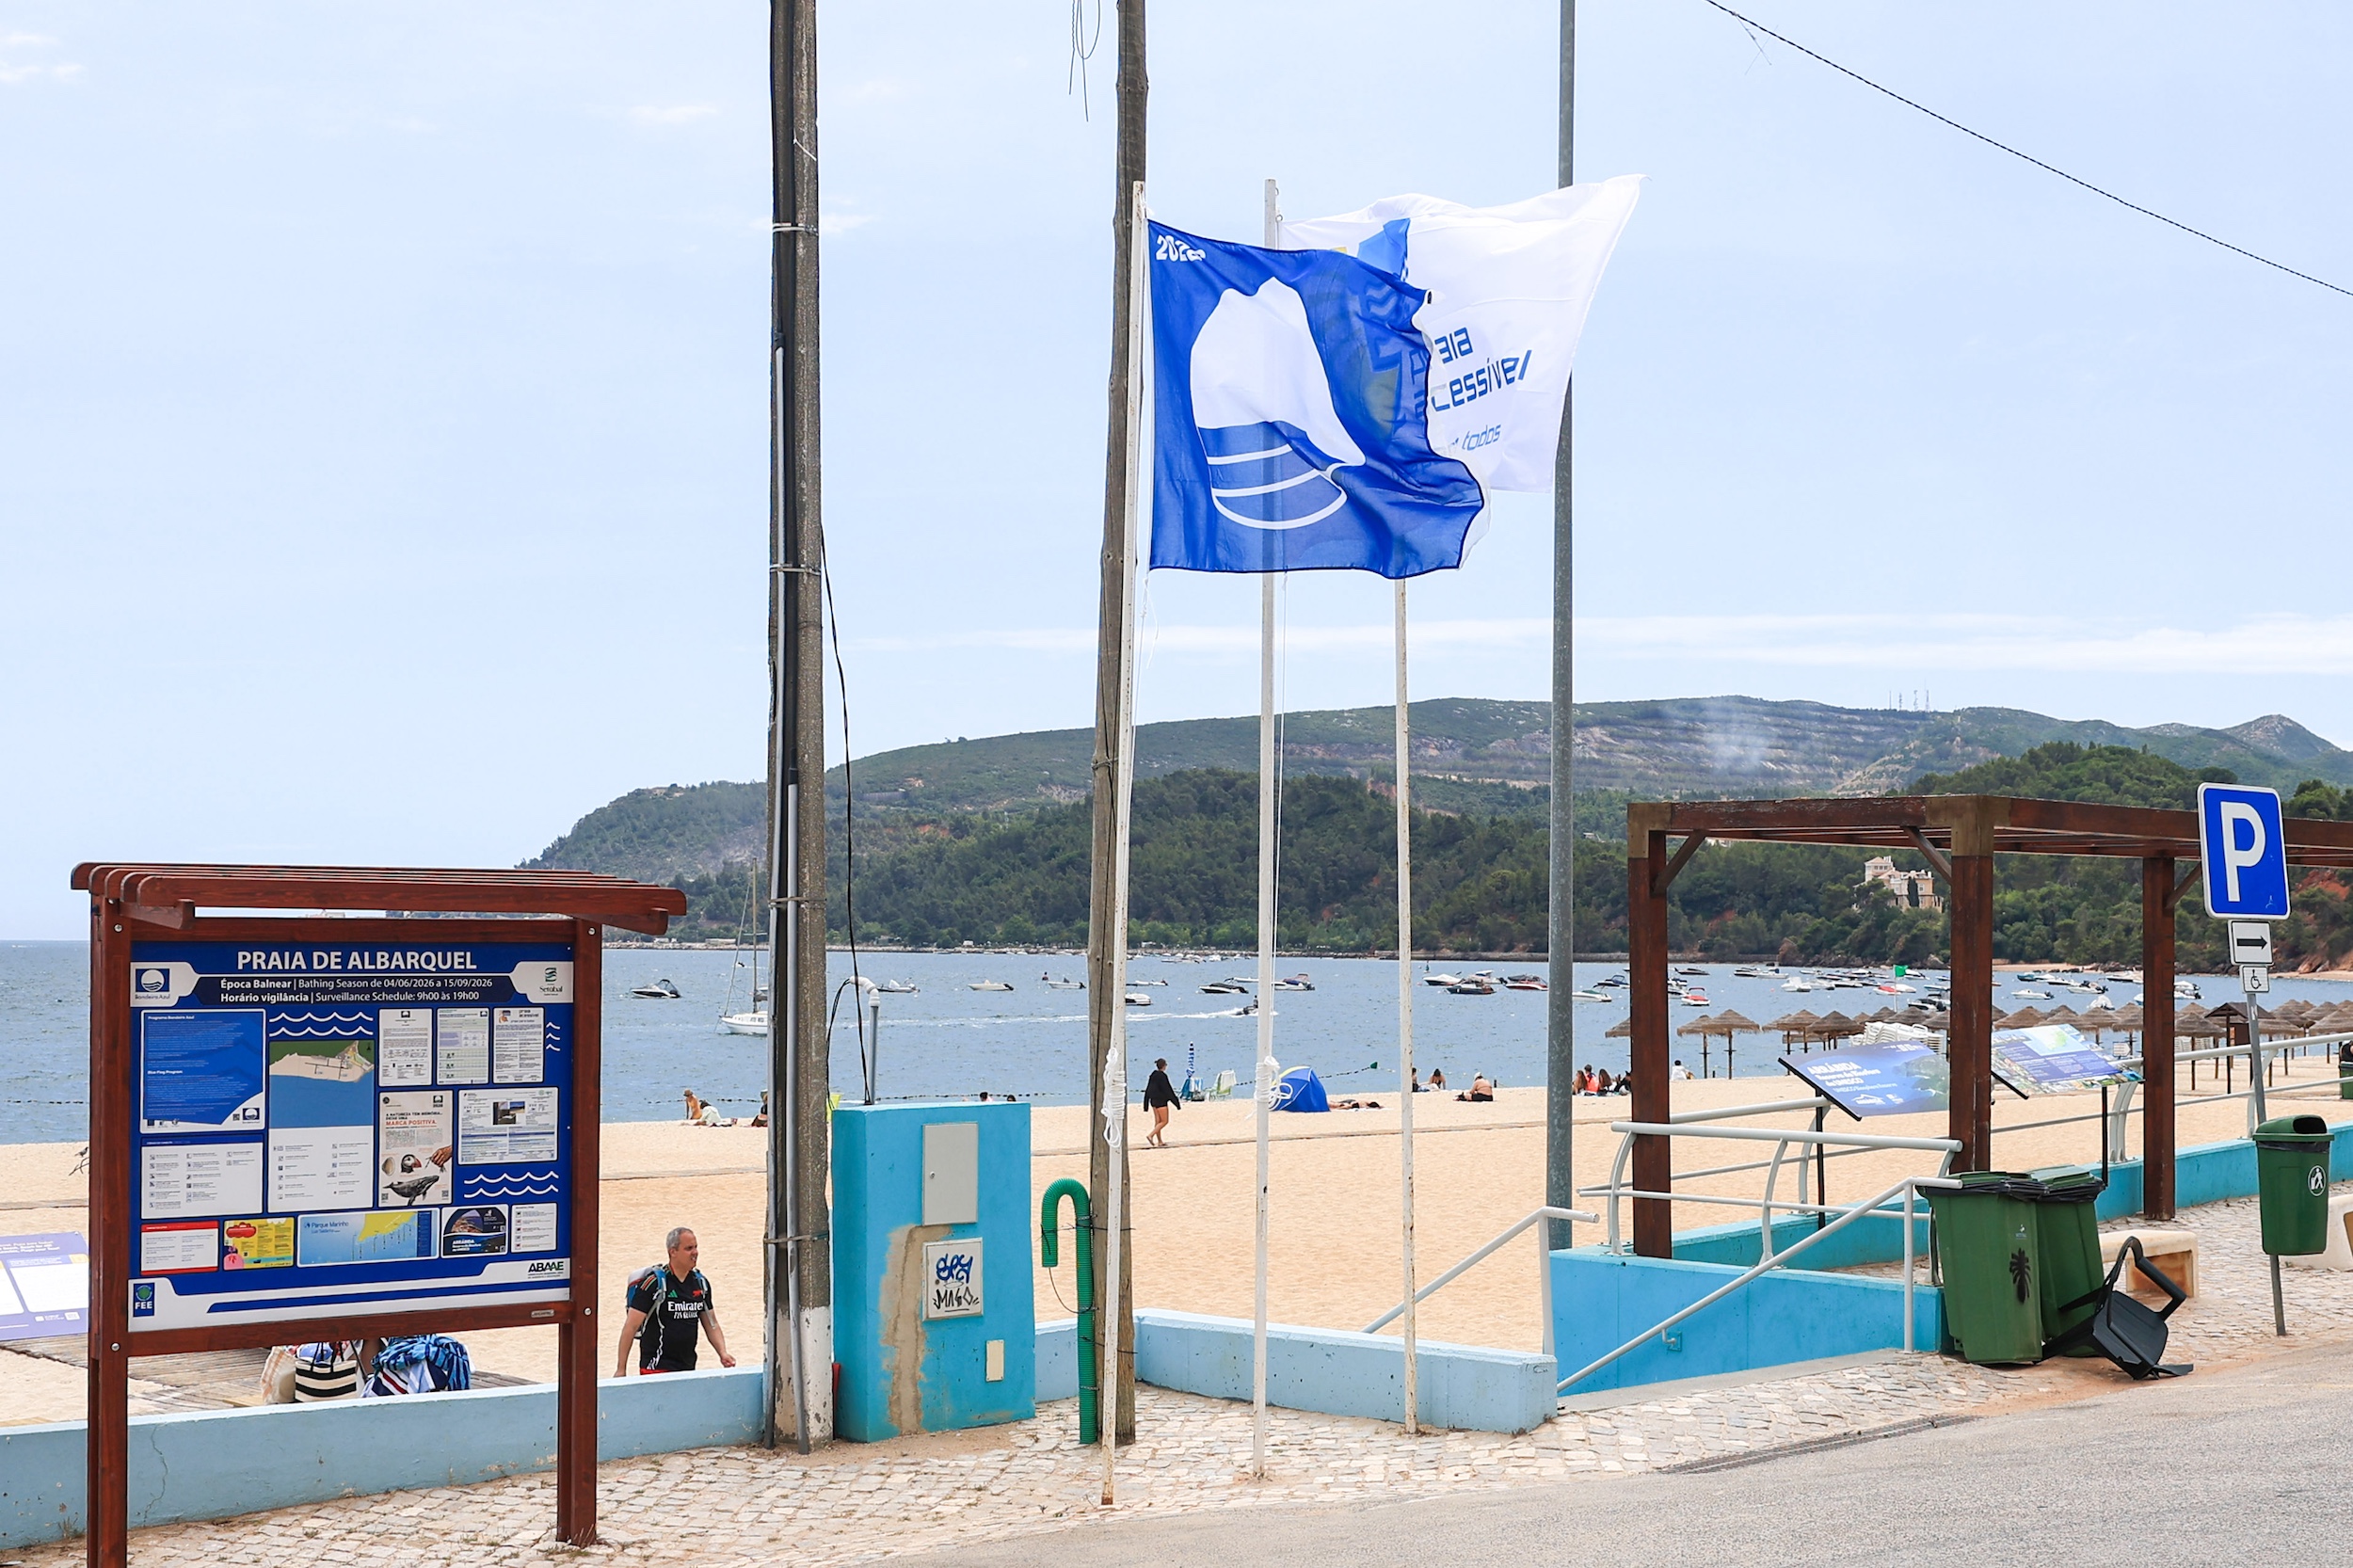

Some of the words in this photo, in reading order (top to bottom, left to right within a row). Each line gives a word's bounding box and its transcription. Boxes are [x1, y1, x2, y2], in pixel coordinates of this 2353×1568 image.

[1462, 424, 1501, 451] todos
[2219, 801, 2266, 902] P
[237, 952, 307, 970] PRAIA
[312, 952, 343, 970] DE
[347, 951, 477, 972] ALBARQUEL
[220, 978, 251, 990] Época
[253, 979, 292, 989] Balnear
[298, 979, 334, 990] Bathing
[336, 979, 369, 988] Season
[370, 979, 382, 988] de
[383, 979, 435, 988] 04/06/2026
[443, 978, 493, 988] 15/09/2026
[220, 992, 260, 1003] Horário
[261, 993, 309, 1004] vigilância
[315, 991, 371, 1002] Surveillance
[372, 991, 416, 1001] Schedule:
[417, 991, 440, 1001] 9h00
[441, 991, 452, 1000] às
[453, 990, 480, 1000] 19h00
[1807, 1062, 1862, 1074] ARRÁBIDA
[135, 1301, 152, 1309] FEE
